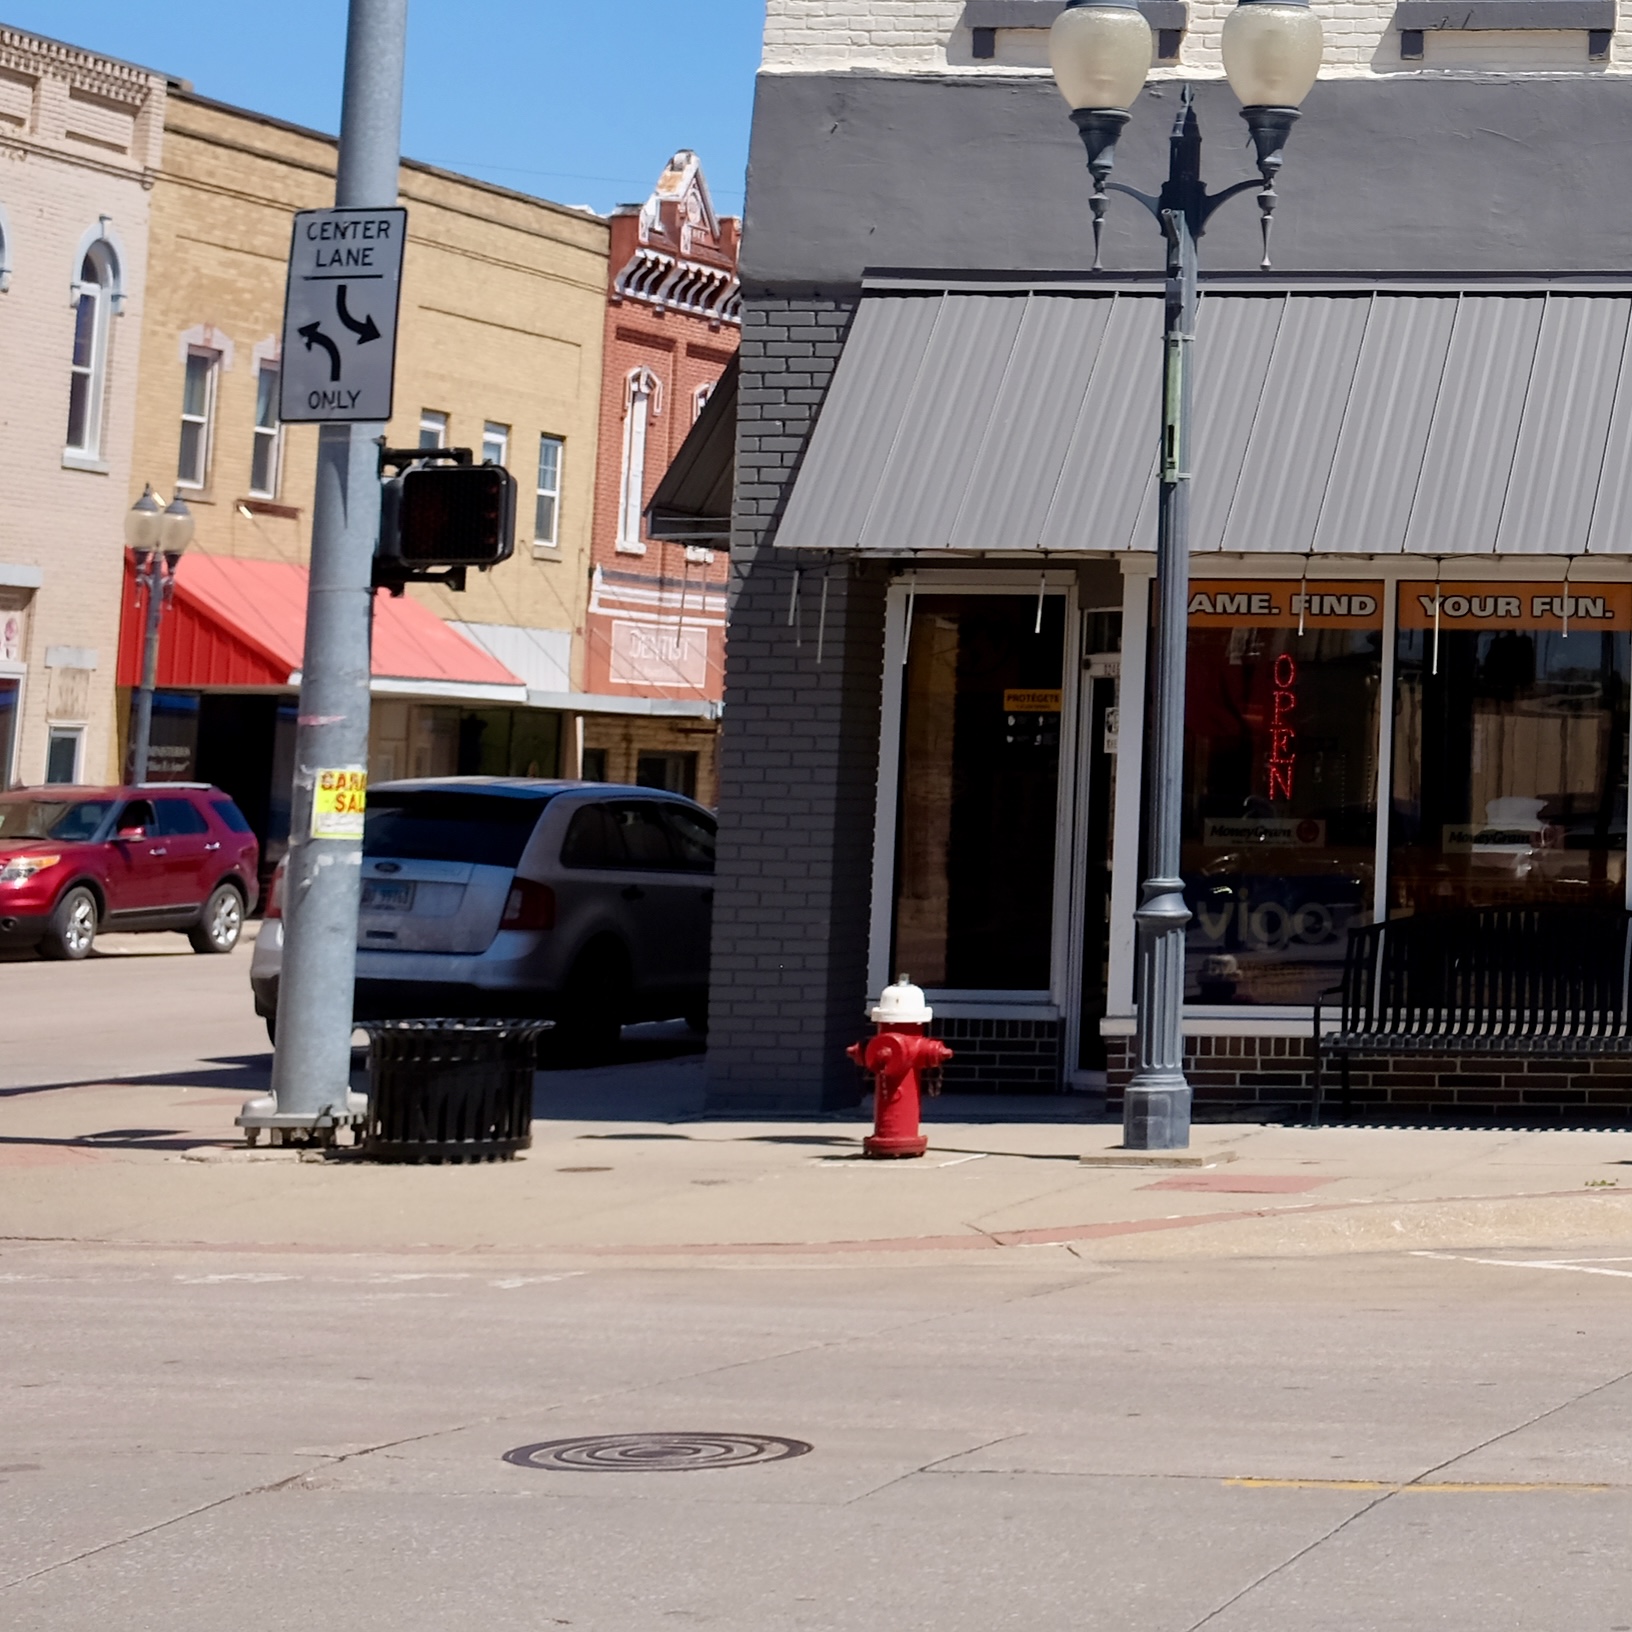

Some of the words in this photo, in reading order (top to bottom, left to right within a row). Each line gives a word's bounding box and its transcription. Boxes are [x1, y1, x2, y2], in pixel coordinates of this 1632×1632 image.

[306, 220, 391, 241] CENTER
[315, 247, 374, 268] LANE
[308, 389, 362, 410] ONLY
[1188, 593, 1280, 614] AME.
[1290, 594, 1378, 616] FIND
[1418, 595, 1521, 618] YOUR
[1532, 596, 1614, 619] FUN.
[630, 629, 691, 661] DENTIST
[1268, 652, 1296, 801] OPEN
[335, 792, 366, 813] SAL
[1210, 825, 1292, 838] MoneyGram
[1448, 831, 1530, 845] MoneyGram
[1196, 887, 1333, 953] vigo
